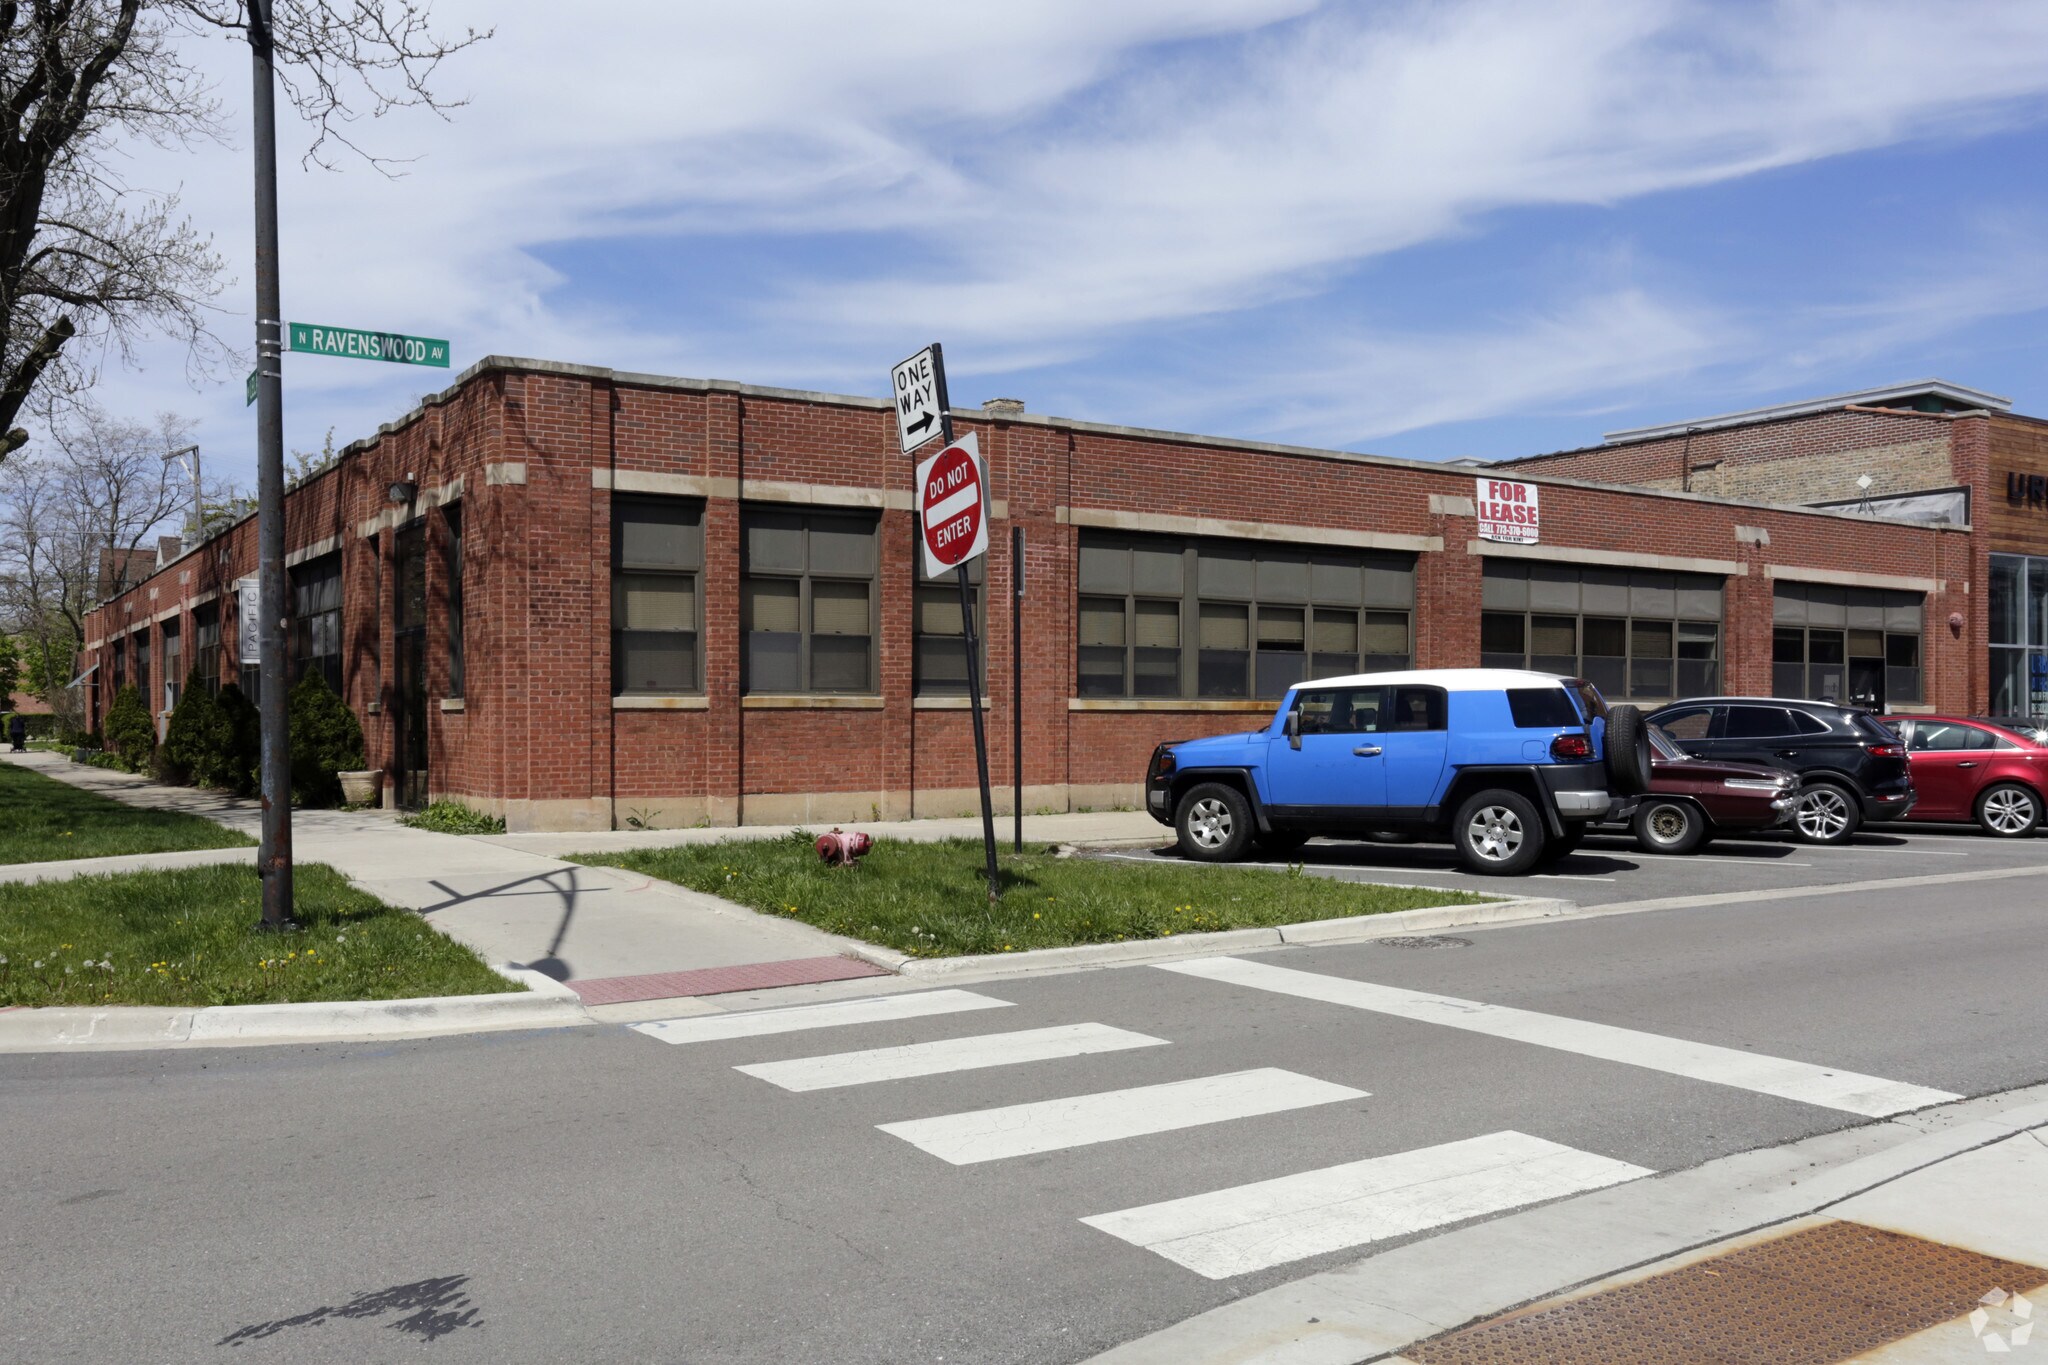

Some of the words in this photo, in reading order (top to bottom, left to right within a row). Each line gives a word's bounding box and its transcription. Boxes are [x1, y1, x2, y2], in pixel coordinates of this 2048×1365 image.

[299, 331, 306, 344] N
[313, 329, 426, 362] RAVENSWOOD
[431, 347, 443, 360] AV
[898, 357, 930, 391] ONE
[900, 380, 932, 416] WAY
[930, 476, 944, 499] DO
[947, 461, 969, 489] NOT
[1488, 481, 1527, 503] FOR
[2007, 472, 2048, 506] UR
[1479, 501, 1538, 525] LEASE
[1479, 522, 1495, 534] CALL
[937, 515, 972, 549] ENTER
[248, 592, 257, 652] PACIFIC
